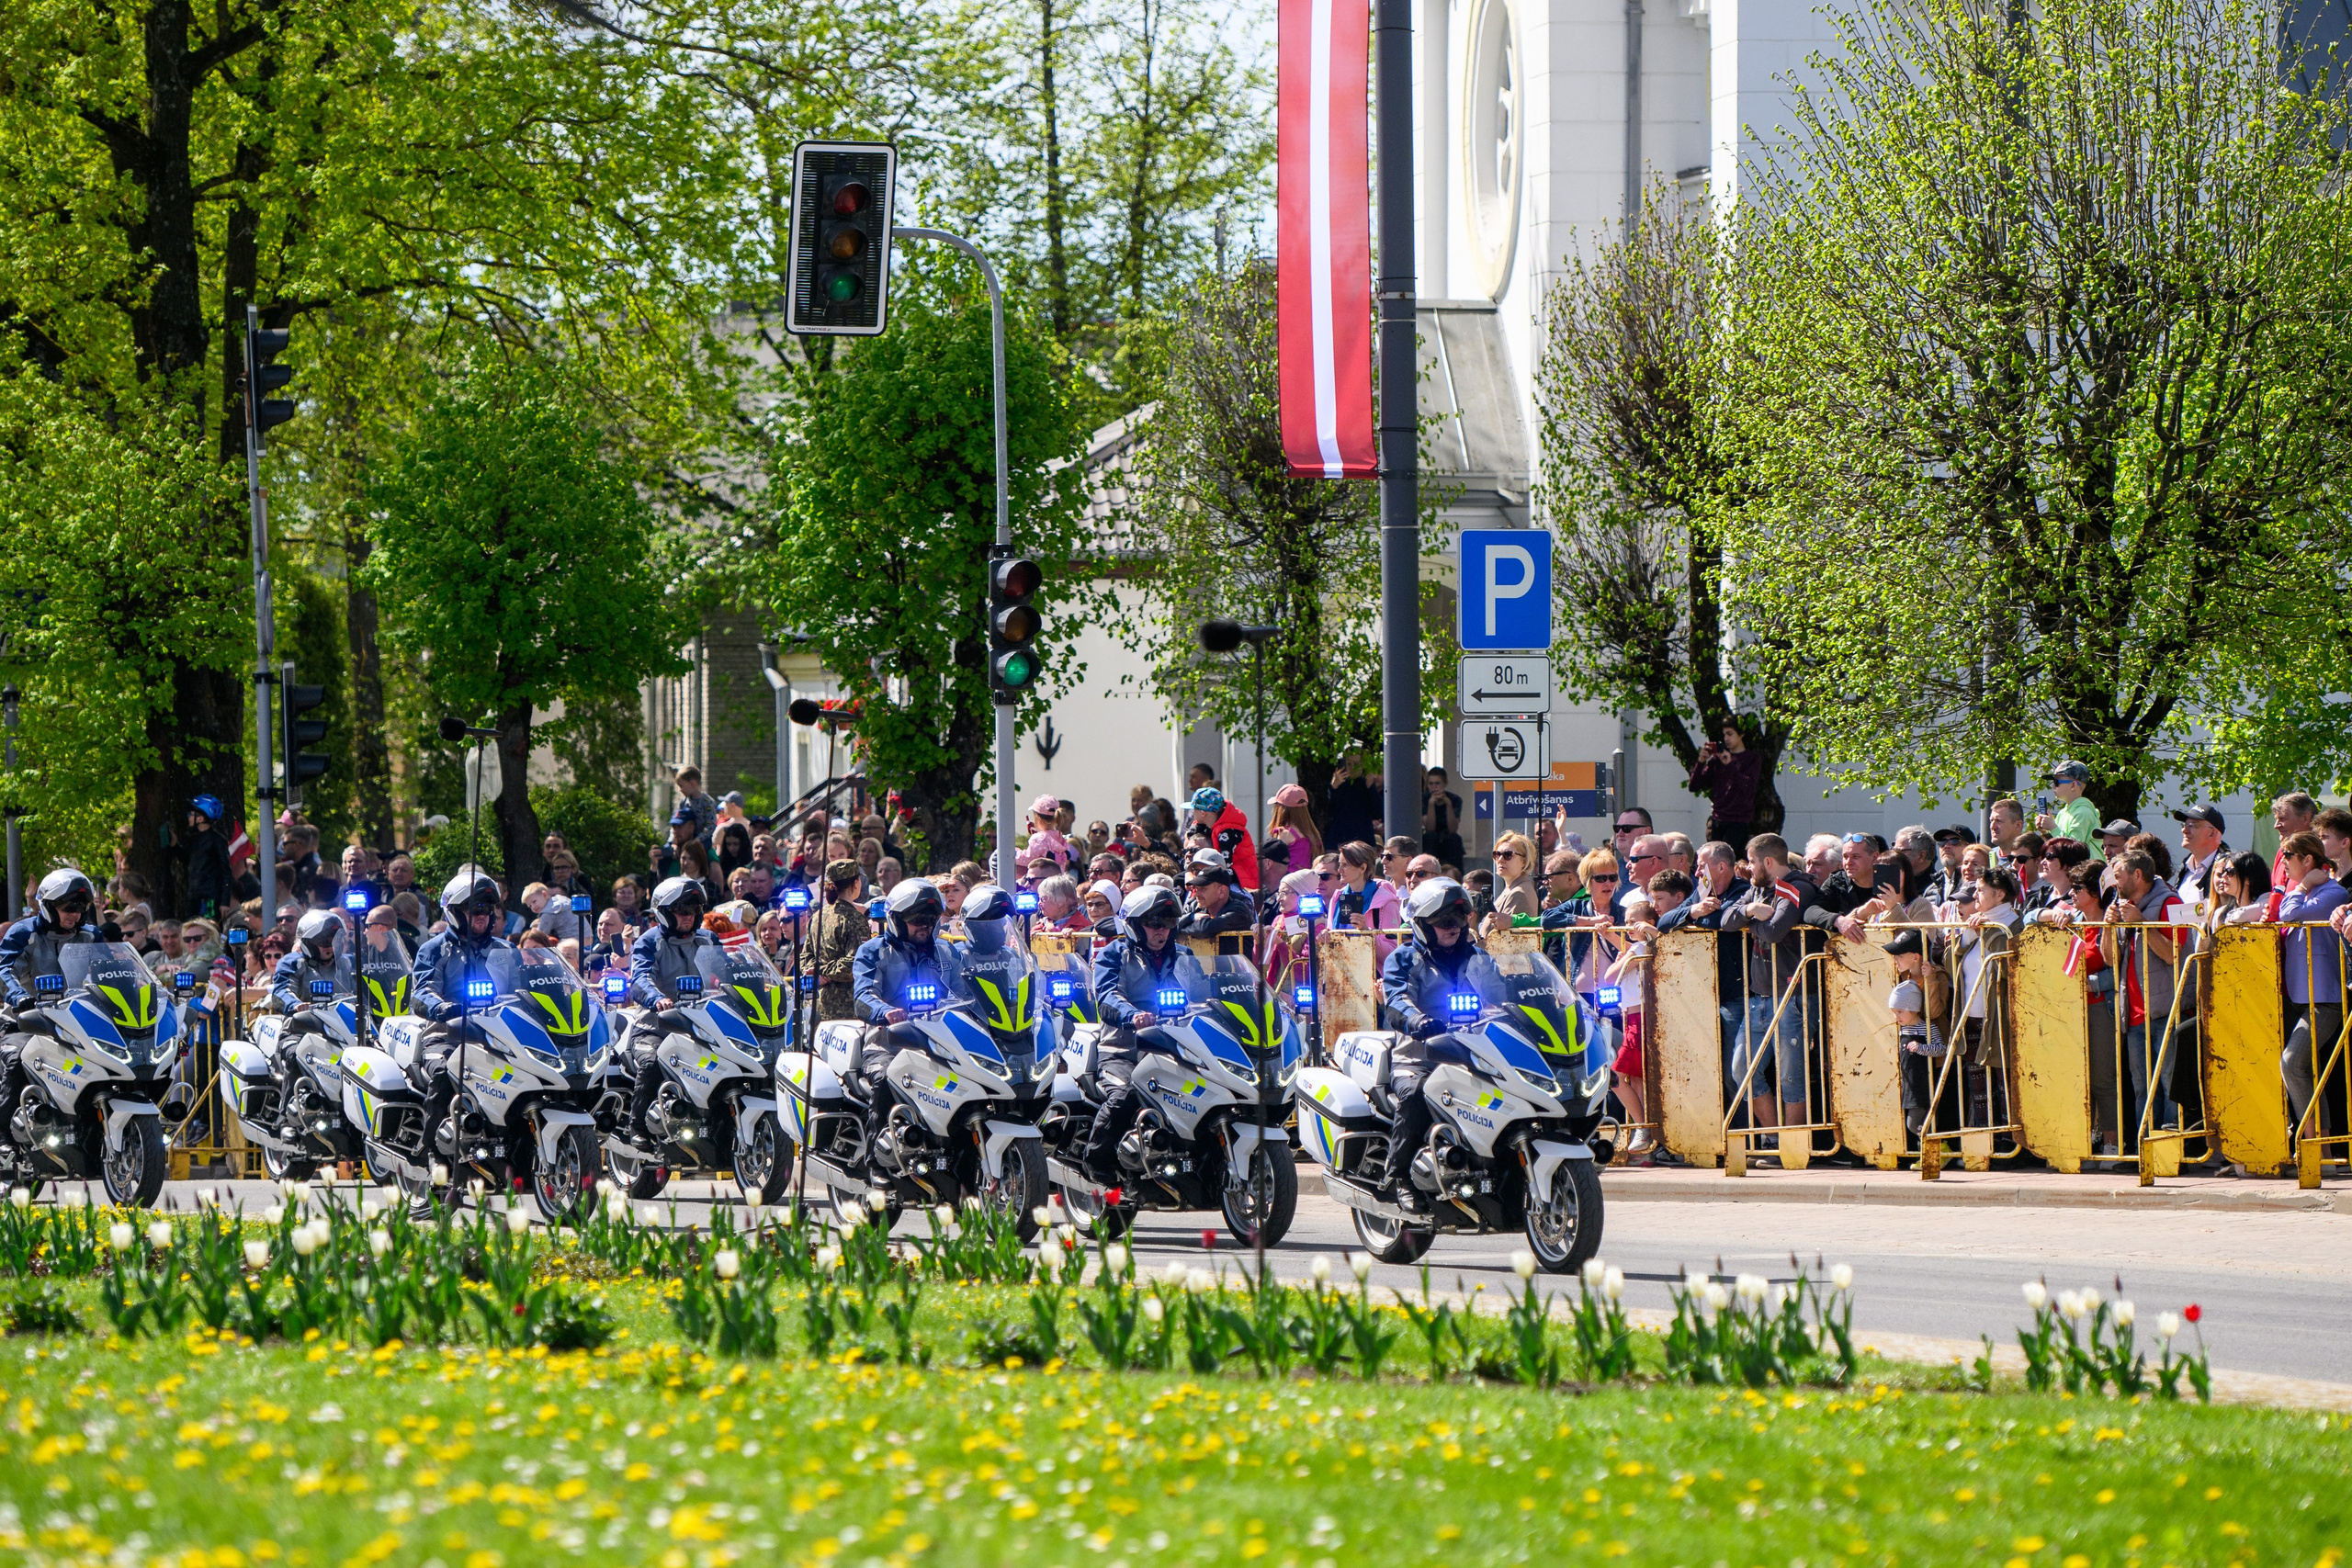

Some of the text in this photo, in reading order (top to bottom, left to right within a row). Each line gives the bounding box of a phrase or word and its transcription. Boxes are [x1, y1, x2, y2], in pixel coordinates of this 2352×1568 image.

[1485, 544, 1535, 636] P
[1494, 665, 1529, 685] 80 m
[362, 962, 402, 971] POLICIJA
[1518, 987, 1555, 999] POLIC
[384, 1022, 411, 1047] POLICIJA
[819, 1029, 847, 1055] POLICIJA
[1340, 1038, 1374, 1068] POLICIJA
[47, 1072, 77, 1091] POLICIJA
[316, 1066, 341, 1081] POLICIJA
[682, 1068, 710, 1086] POLICIJA
[475, 1082, 507, 1101] POLICIJA
[917, 1090, 951, 1111] POLICIJA
[1163, 1092, 1198, 1115] POLICIJA
[1457, 1108, 1494, 1130] POLICIJA
